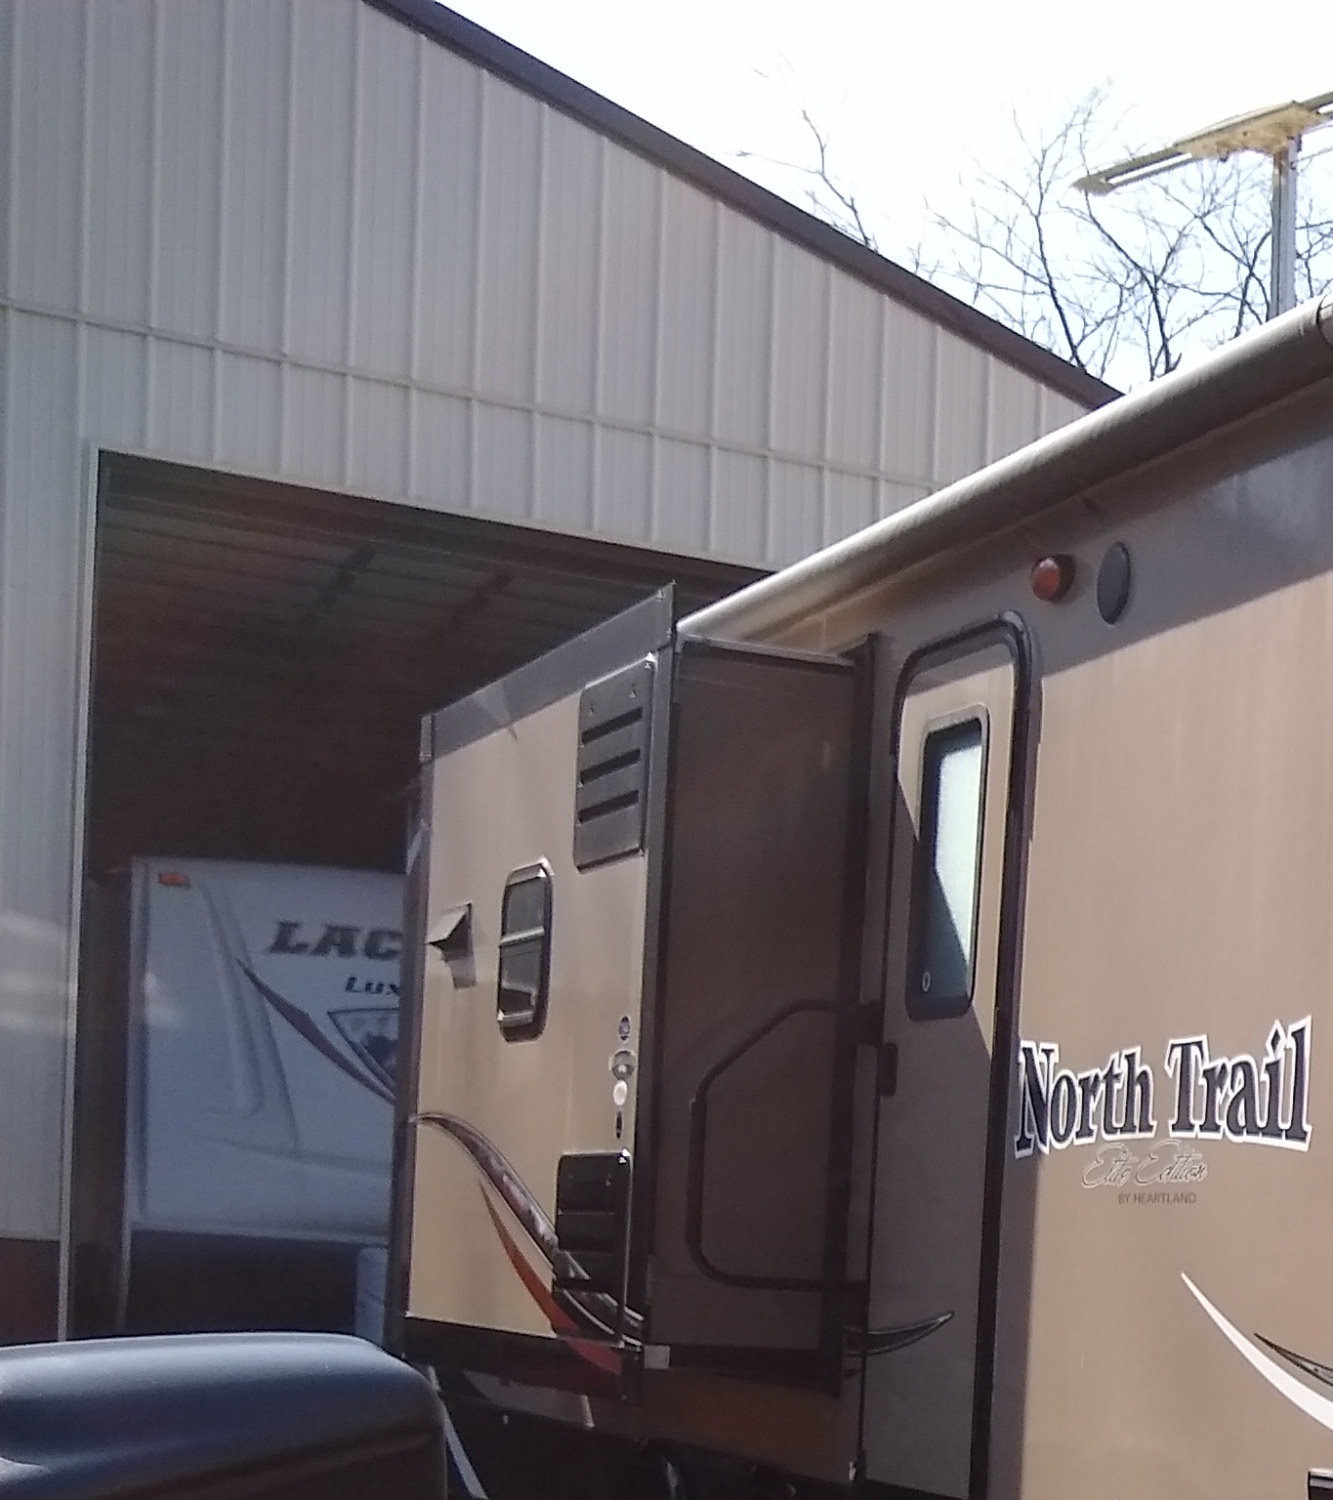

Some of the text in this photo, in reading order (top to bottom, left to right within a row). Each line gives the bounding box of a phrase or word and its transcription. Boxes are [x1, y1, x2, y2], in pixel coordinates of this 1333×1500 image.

[1014, 1015, 1313, 1159] North Trail
[1118, 1193, 1198, 1204] BY HEARTLAND
